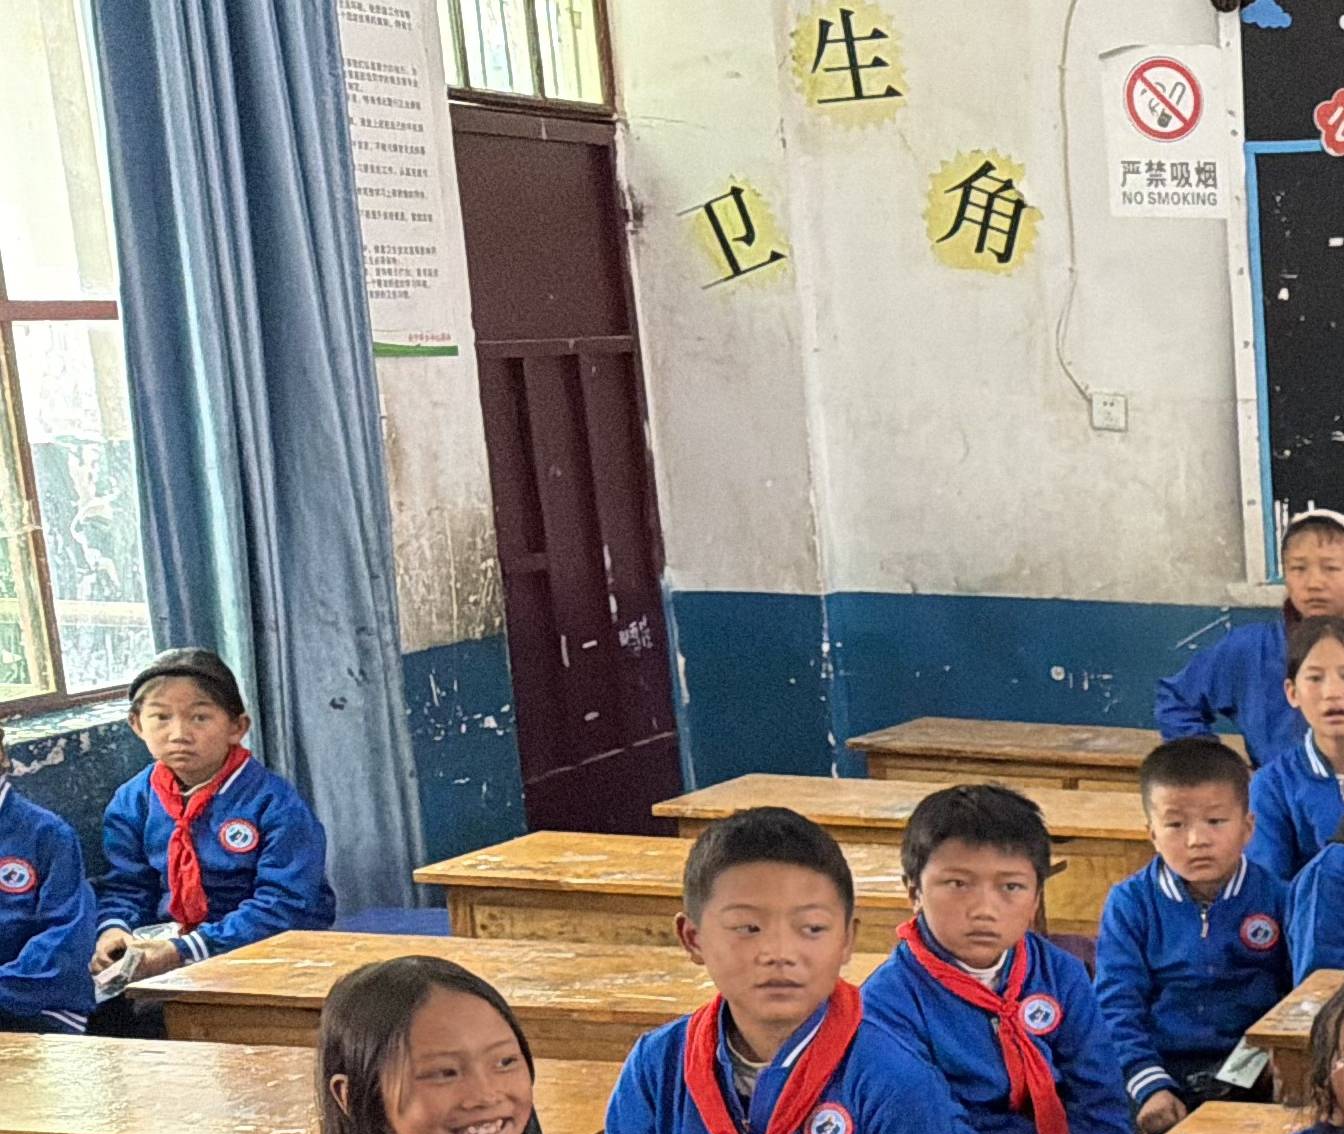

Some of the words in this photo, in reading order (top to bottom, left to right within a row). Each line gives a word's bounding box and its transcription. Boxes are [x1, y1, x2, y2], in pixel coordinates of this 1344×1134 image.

[1121, 160, 1218, 189] 严禁吸烟
[1122, 191, 1143, 206] NO
[1147, 191, 1218, 206] SMOKING
